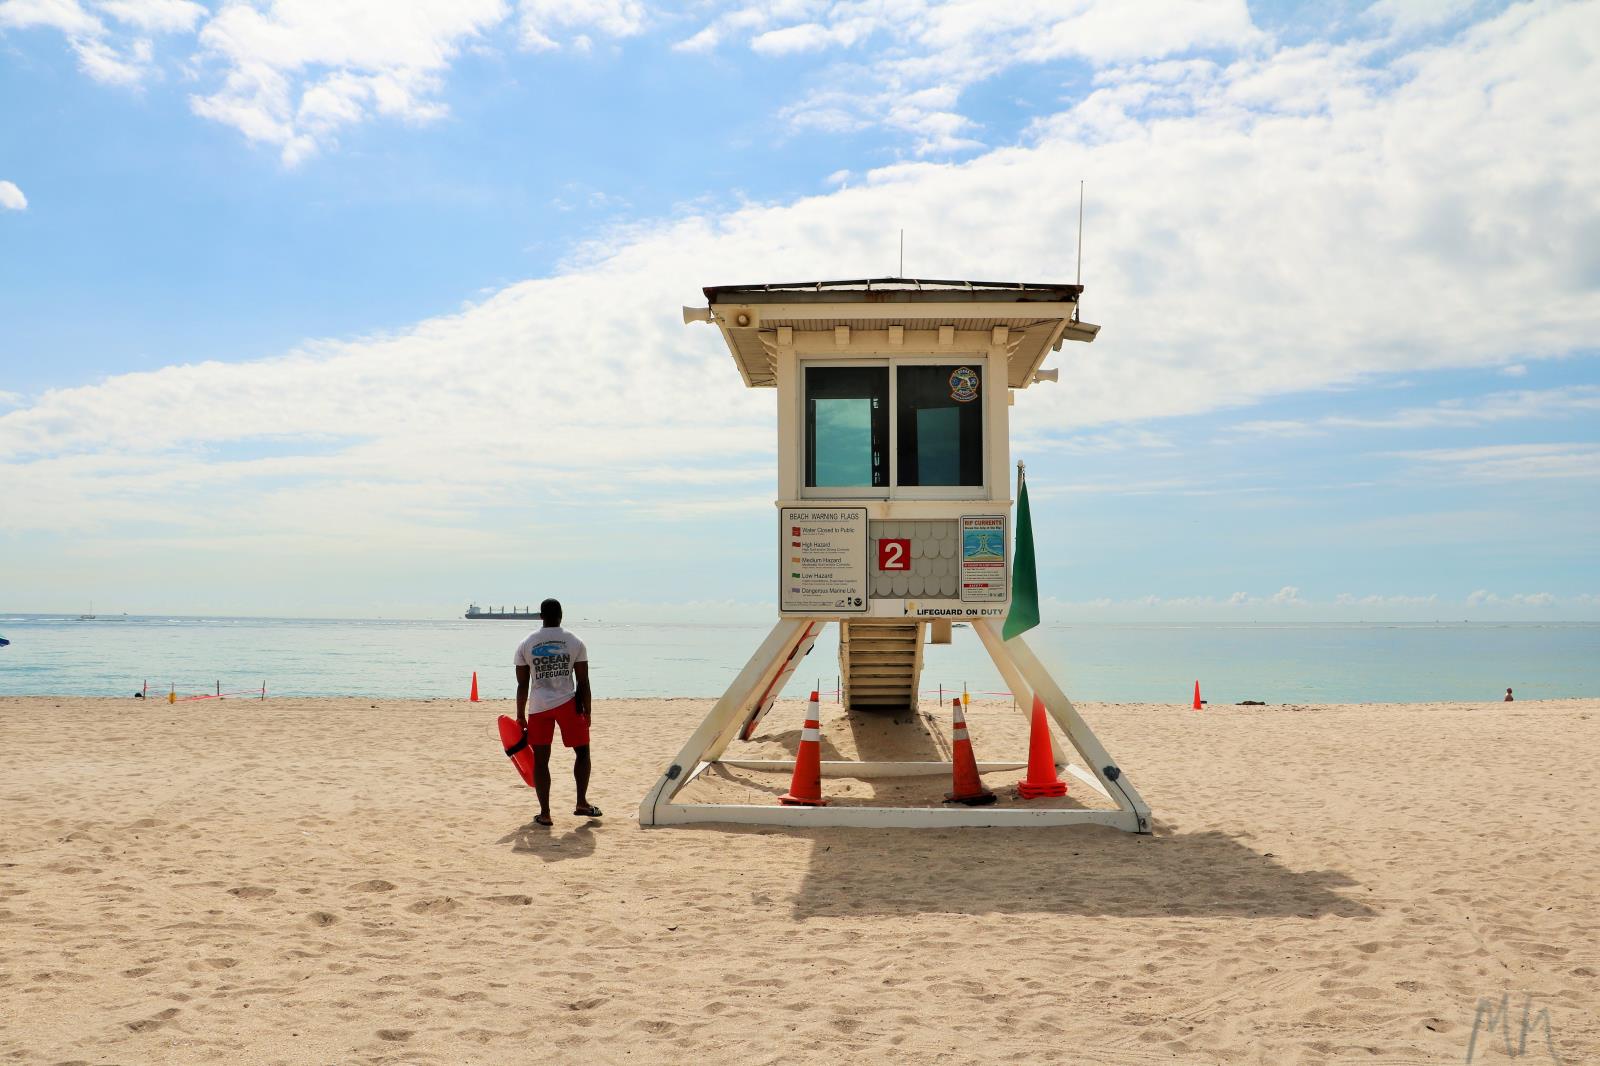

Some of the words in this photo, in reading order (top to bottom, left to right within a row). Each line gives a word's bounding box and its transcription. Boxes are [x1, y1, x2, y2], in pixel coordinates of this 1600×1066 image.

[884, 542, 904, 568] 2
[532, 654, 570, 666] OCEAN
[535, 662, 568, 672] RESCUE
[536, 670, 570, 680] LIFEGUARD
